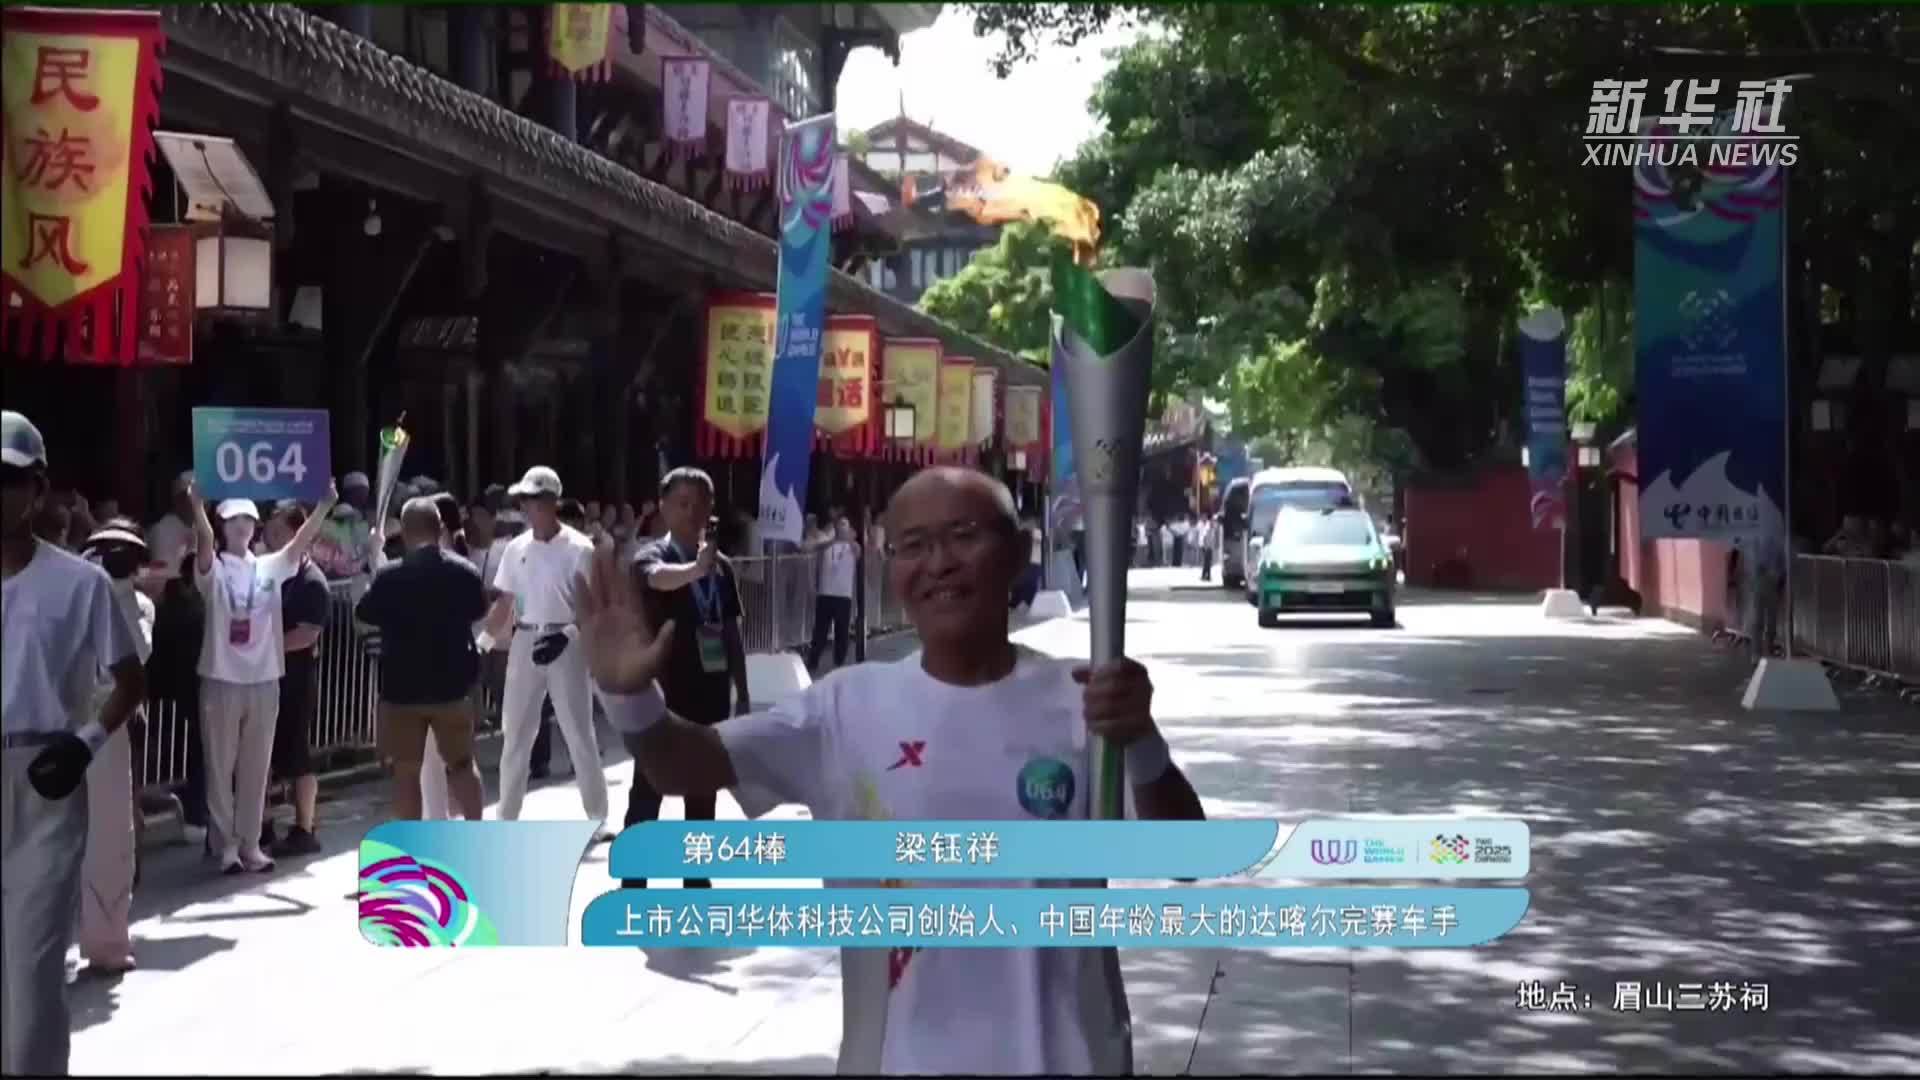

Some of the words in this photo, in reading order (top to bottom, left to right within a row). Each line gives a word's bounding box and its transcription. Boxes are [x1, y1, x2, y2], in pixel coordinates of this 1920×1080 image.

[18, 46, 100, 277] 民族风
[216, 441, 307, 483] 064
